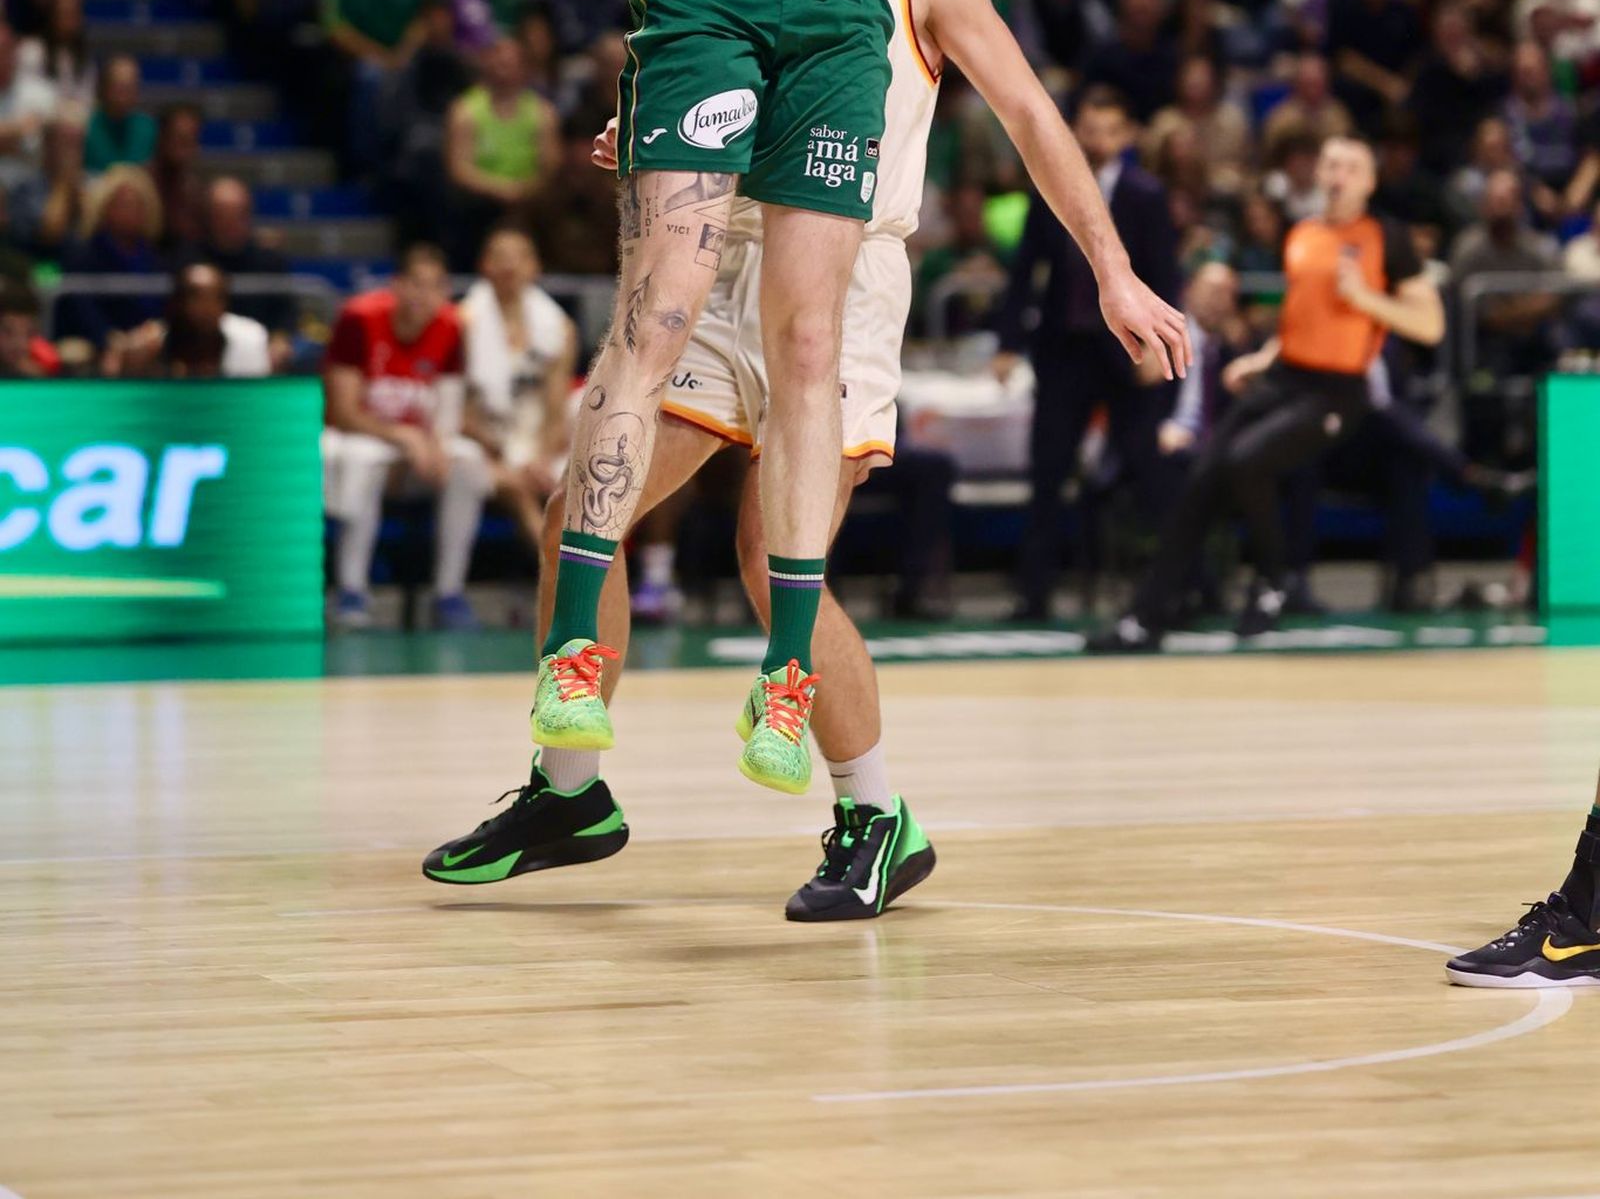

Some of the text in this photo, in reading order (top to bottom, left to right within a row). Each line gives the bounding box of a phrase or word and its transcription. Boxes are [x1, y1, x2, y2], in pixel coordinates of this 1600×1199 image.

[809, 124, 848, 140] sabor
[807, 140, 815, 150] a
[815, 136, 859, 162] má
[804, 152, 856, 188] laga
